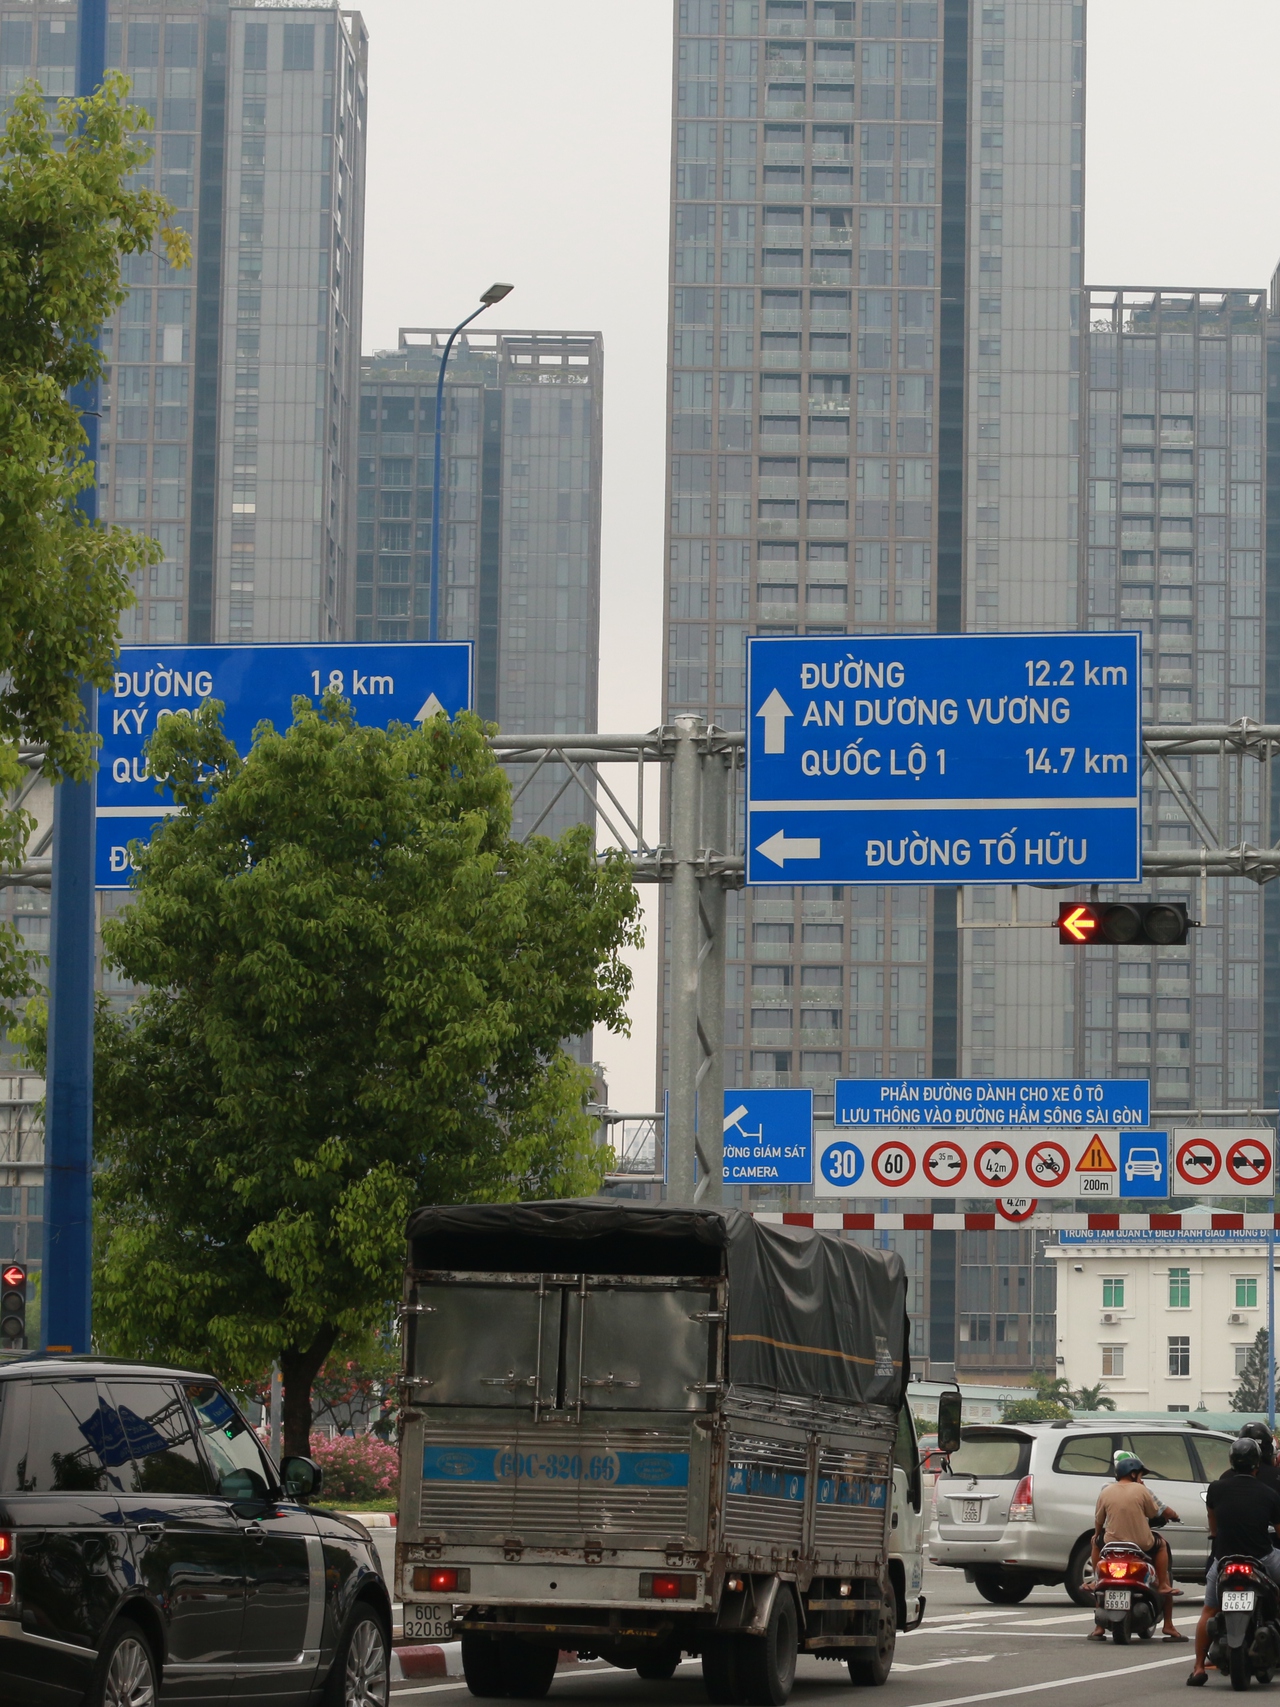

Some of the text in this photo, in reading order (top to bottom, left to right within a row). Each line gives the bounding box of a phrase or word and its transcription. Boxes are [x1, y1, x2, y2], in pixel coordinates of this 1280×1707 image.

[114, 663, 213, 697] ĐƯỜNG
[353, 670, 393, 694] km
[800, 653, 905, 690] ĐƯỜNG
[1025, 659, 1128, 687] 12.2 km
[113, 702, 148, 734] KÝ
[802, 694, 1070, 727] AN DƯƠNG VƯƠNG
[113, 757, 189, 783] QU
[801, 737, 946, 781] QUỐC LỘ 1
[1025, 747, 1128, 774] 14.7 km
[865, 826, 1087, 867] ĐƯỜNG TỐ HỮU
[880, 1081, 1104, 1102] PHẦN ĐƯỜNG DÀNH CHO XE Ô TÔ
[842, 1102, 1142, 1124] LƯU THÔNG VÀO ĐƯỜNG HẦM SÔNG SÀI GÒN
[723, 1144, 806, 1158] ỜNG GIÁM SÁT
[884, 1153, 903, 1174] 60
[939, 1153, 947, 1161] 35
[733, 1167, 778, 1177] CAMERA
[829, 1149, 856, 1179] 30
[986, 1158, 1006, 1173] 4.2m
[1083, 1179, 1108, 1191] 200m
[501, 1453, 614, 1480] 60C-320.66
[416, 1606, 441, 1620] 60C
[406, 1622, 450, 1636] 320.66
